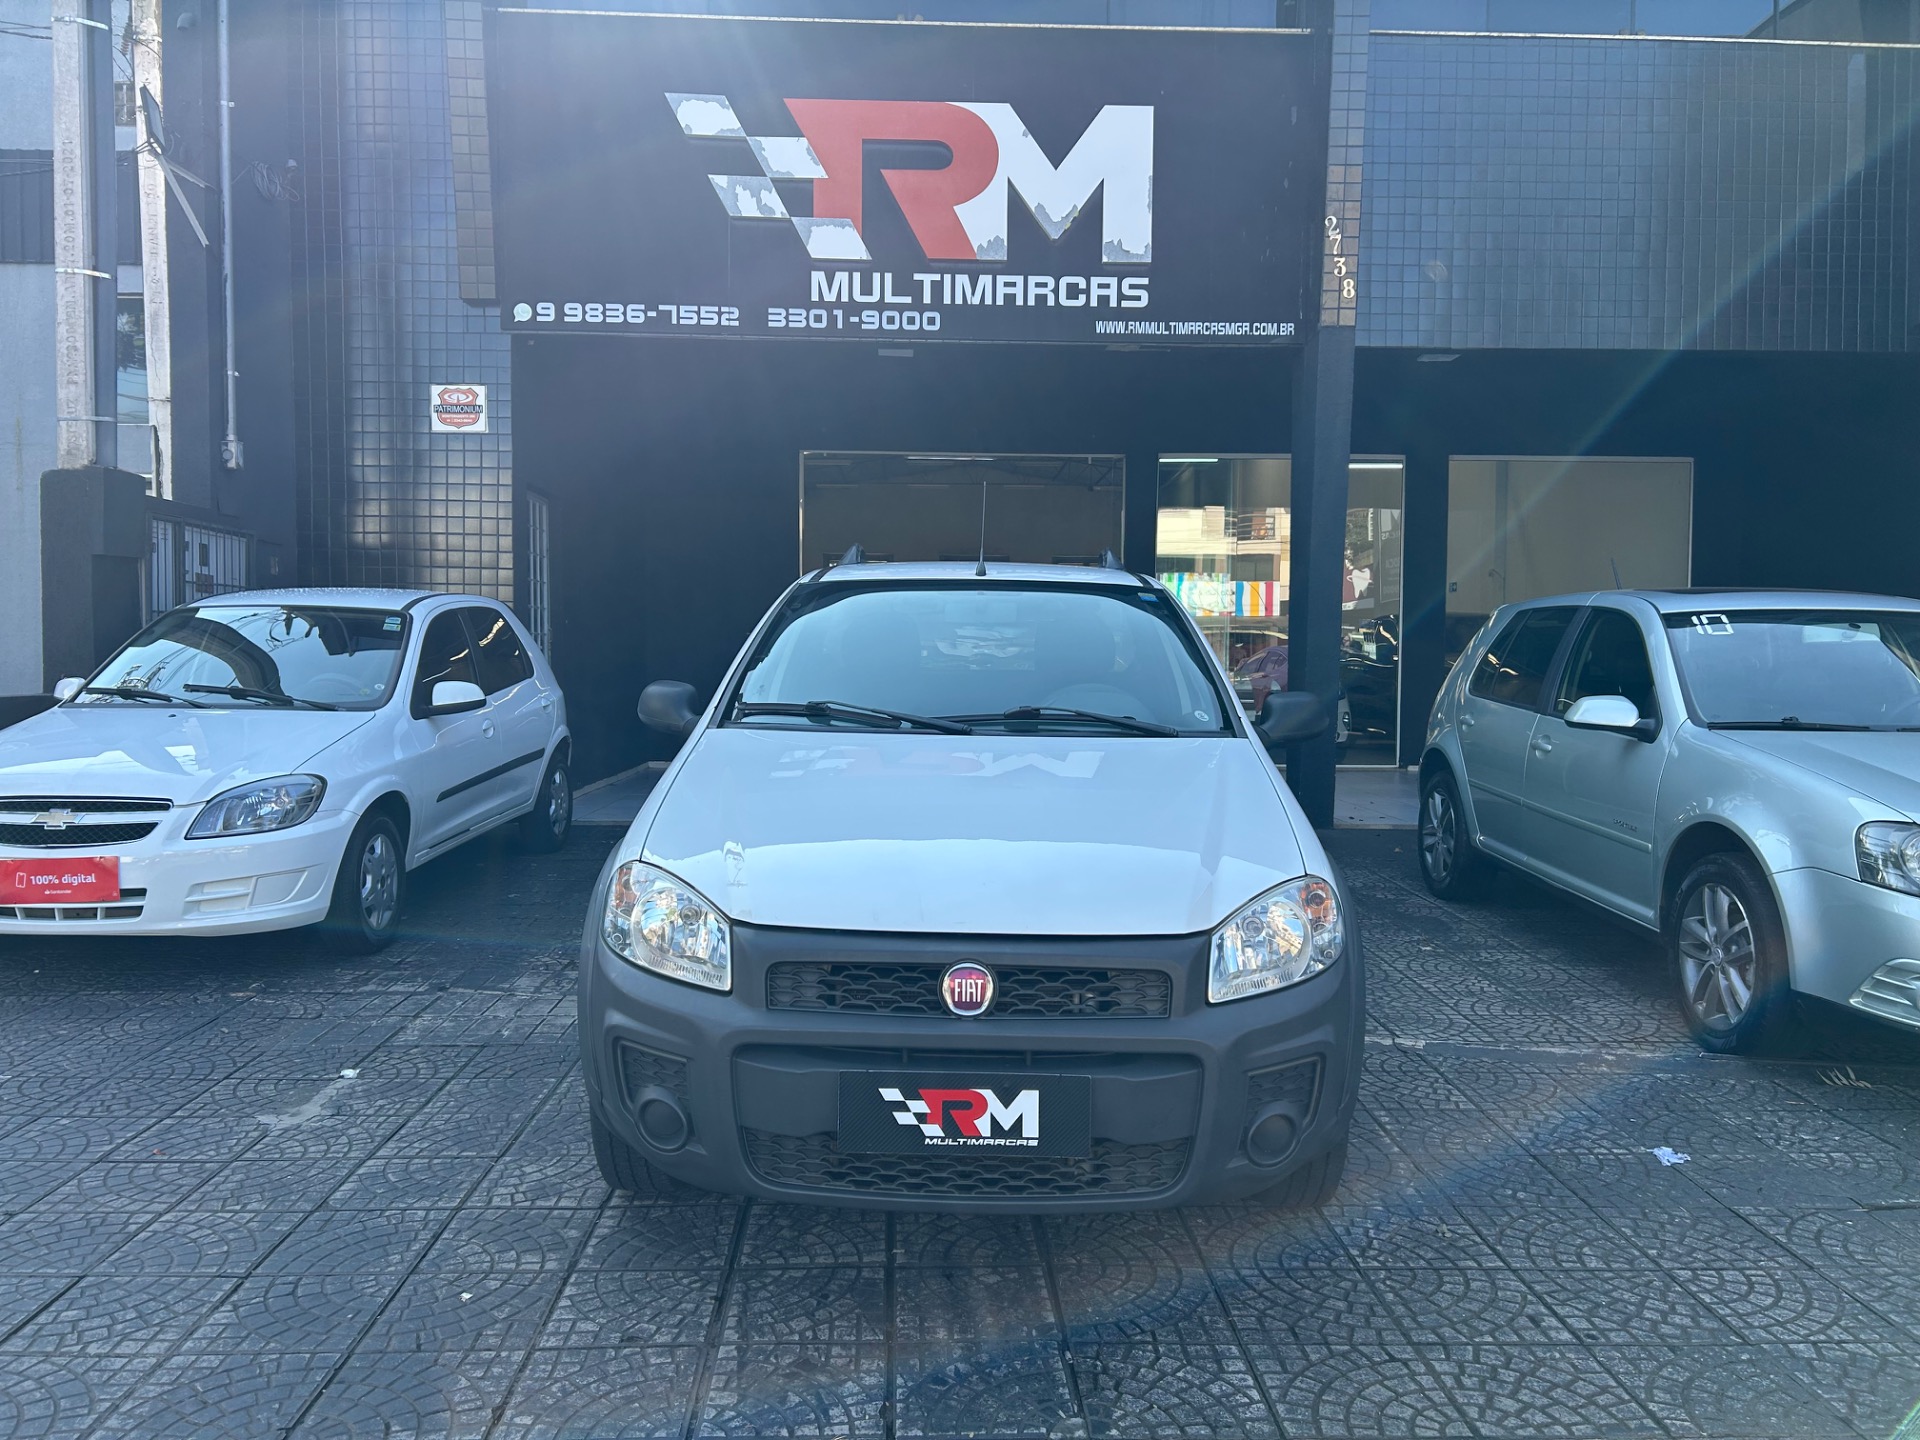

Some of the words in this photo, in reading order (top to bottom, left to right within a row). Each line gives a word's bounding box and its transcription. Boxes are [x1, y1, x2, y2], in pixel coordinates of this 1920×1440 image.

[783, 98, 1154, 263] RM
[811, 271, 1150, 307] MULTIMARCAS
[536, 302, 555, 322] 9
[564, 303, 740, 326] 9836-7552
[768, 307, 941, 331] 3301-9000
[1095, 320, 1295, 336] WWW.RMMULTIMARCASMGA.COM.BR
[434, 405, 483, 413] PATRIMONIUM
[1691, 614, 1734, 635] 10
[30, 875, 59, 885] 100%
[62, 873, 96, 886] digital
[954, 978, 985, 1003] FIAT
[918, 1089, 1039, 1138] RM
[924, 1137, 1039, 1147] MULTIMARCAS
